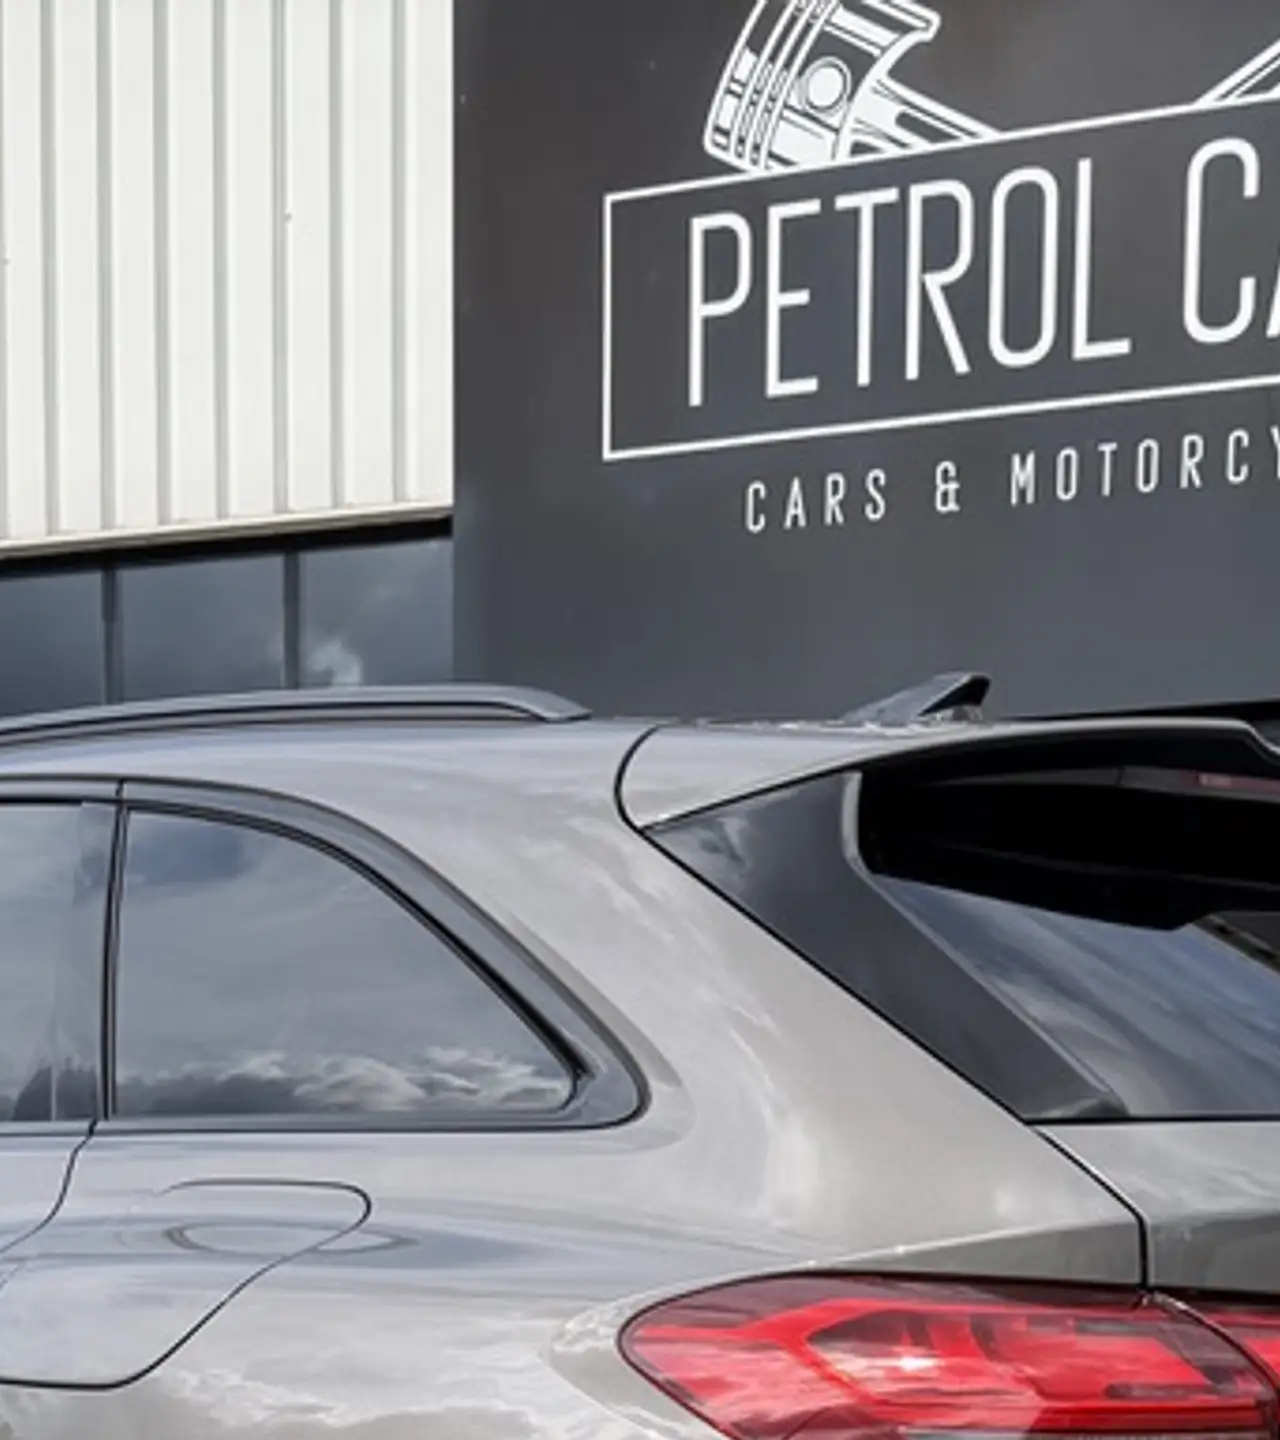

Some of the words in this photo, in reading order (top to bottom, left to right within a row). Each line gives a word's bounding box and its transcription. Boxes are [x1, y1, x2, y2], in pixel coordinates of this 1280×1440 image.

[688, 157, 1132, 407] PETROL
[745, 468, 887, 534] CARS
[934, 460, 961, 514] &
